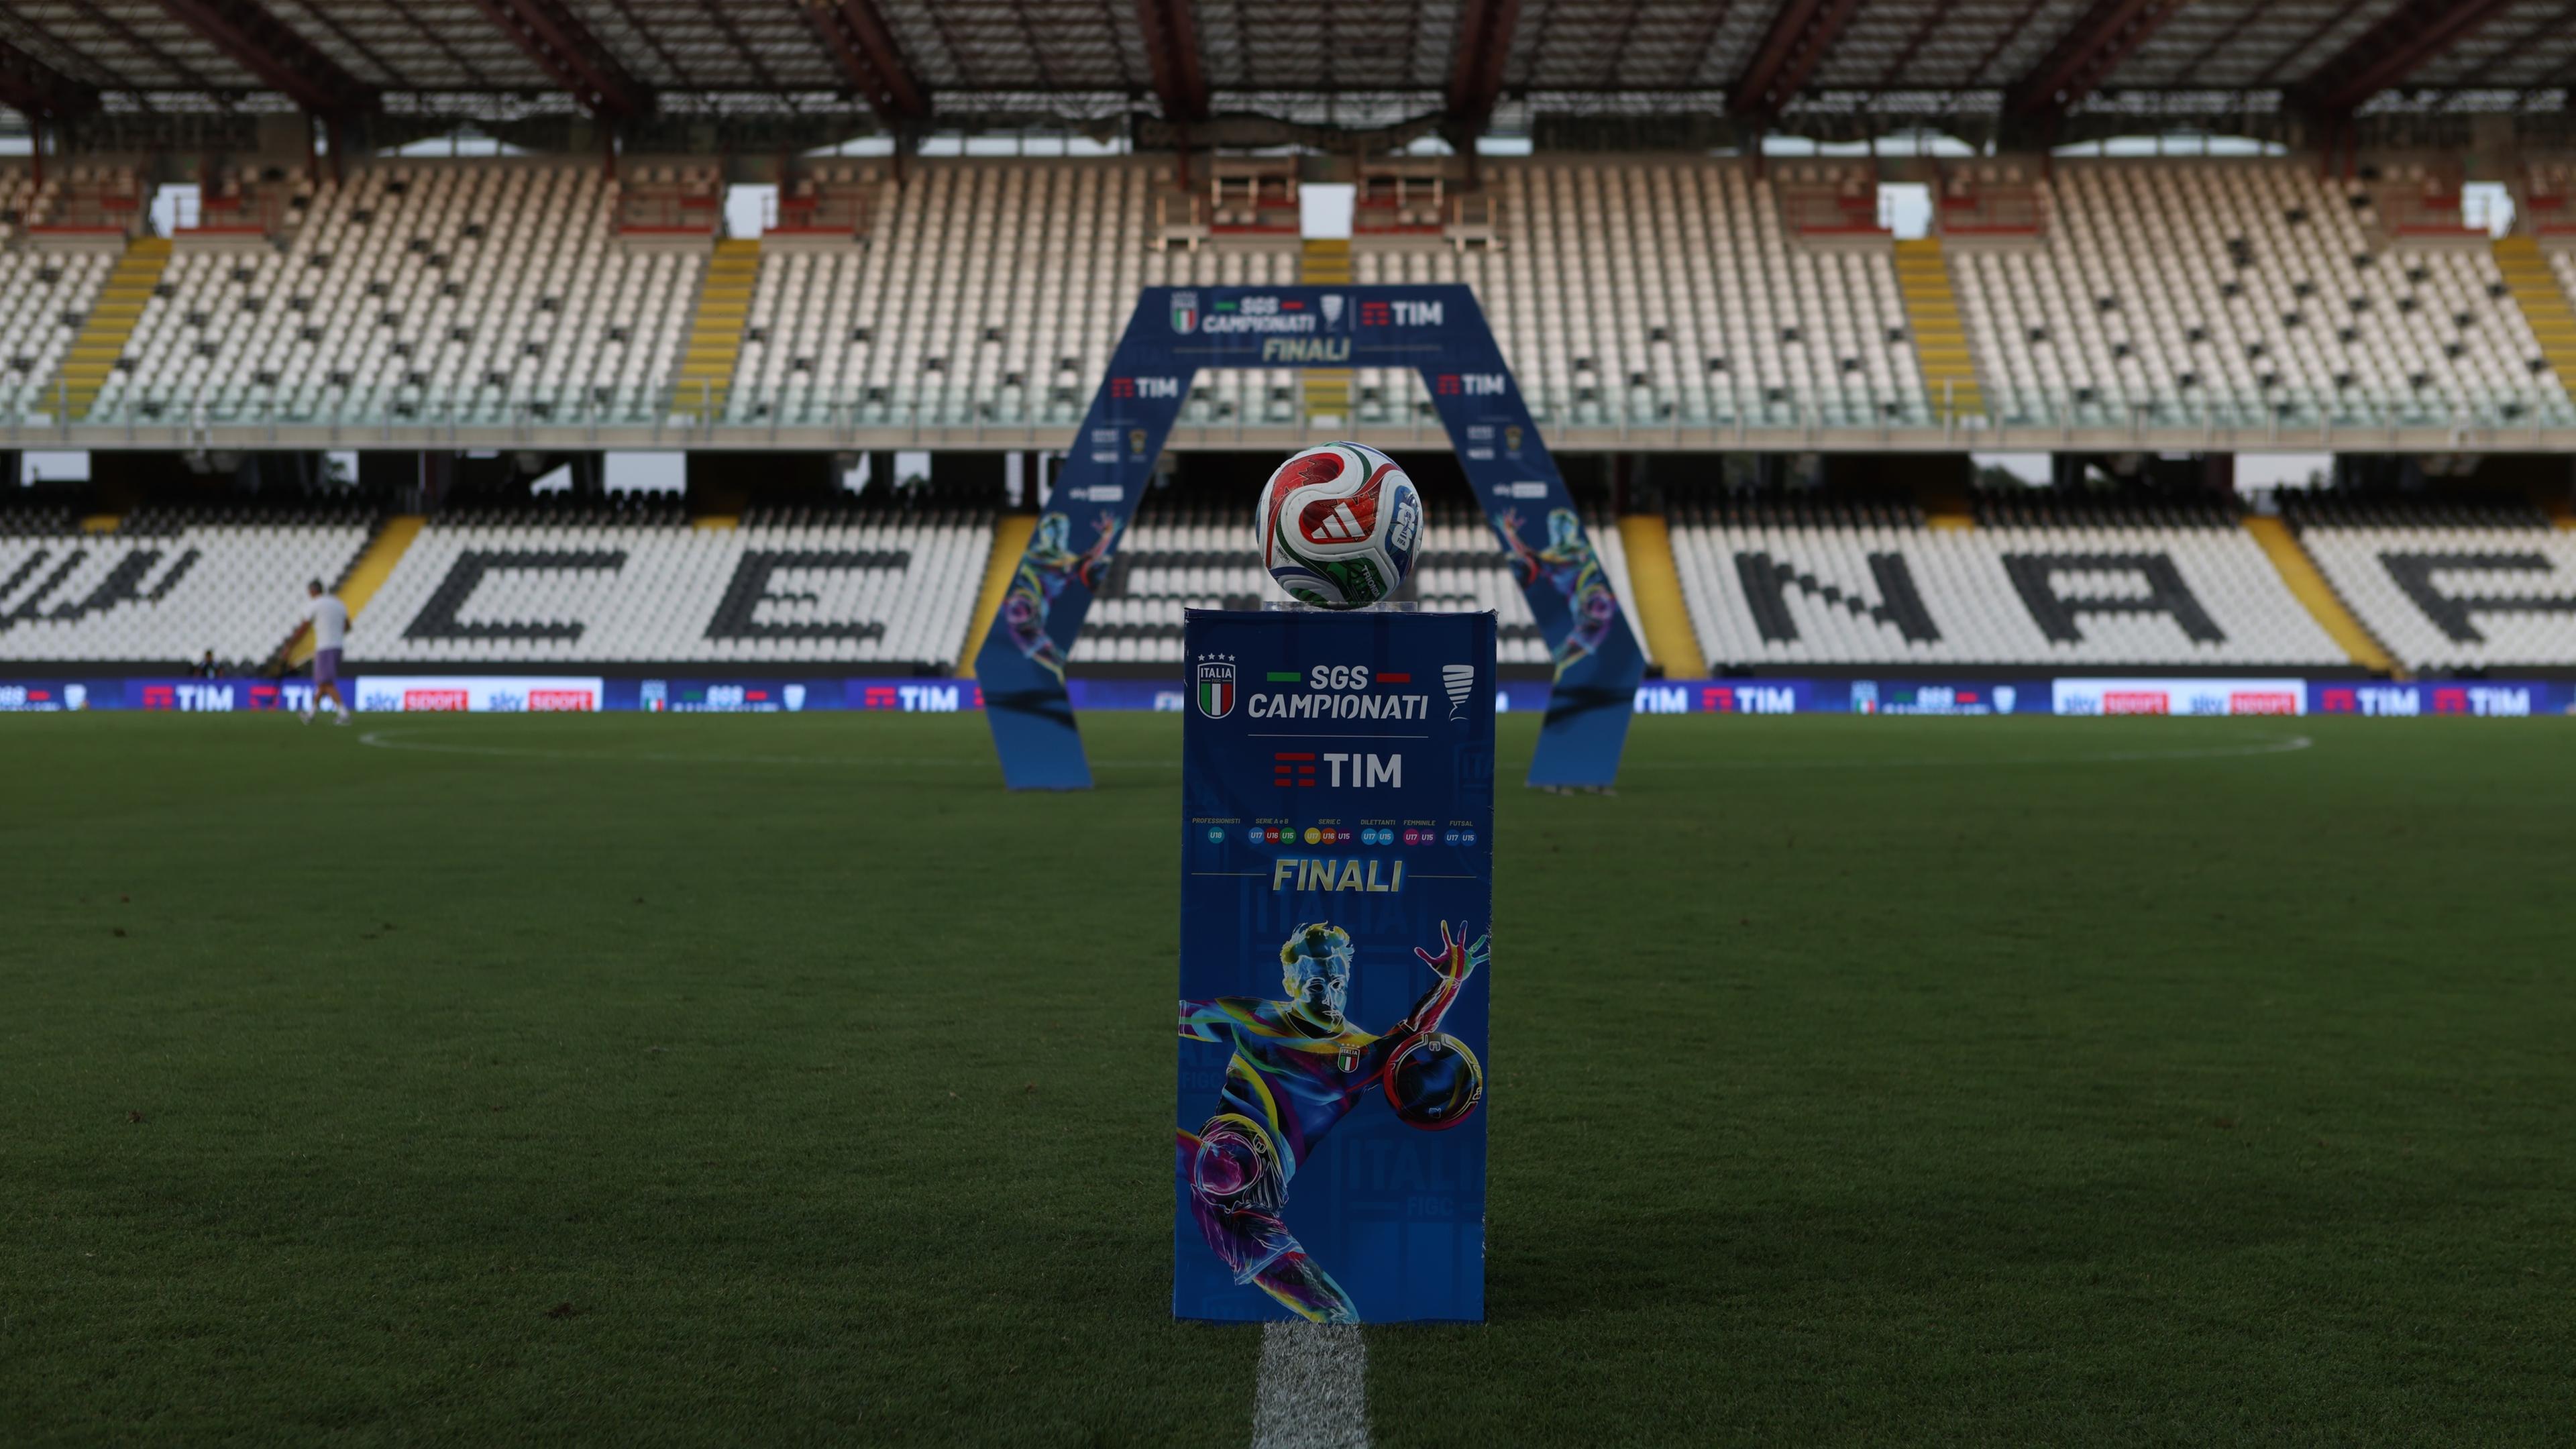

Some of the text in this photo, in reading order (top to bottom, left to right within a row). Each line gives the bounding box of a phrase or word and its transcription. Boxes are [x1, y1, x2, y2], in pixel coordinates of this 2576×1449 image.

[1391, 300, 1443, 327] TIM
[1262, 337, 1351, 362] FINALI
[1135, 376, 1179, 398] TIM
[1461, 373, 1505, 396] TIM
[1397, 537, 1406, 546] FIFA
[1201, 667, 1233, 678] ITALIA
[1310, 665, 1369, 690] SGS
[176, 685, 234, 712] TIM
[899, 686, 959, 712] TIM
[1248, 693, 1429, 720] CAMPIONATI
[1735, 686, 1794, 714] TIM
[2357, 688, 2420, 716] TIM
[2467, 688, 2530, 716] TIM
[1323, 753, 1402, 788] TIM
[1273, 858, 1403, 892] FINALI
